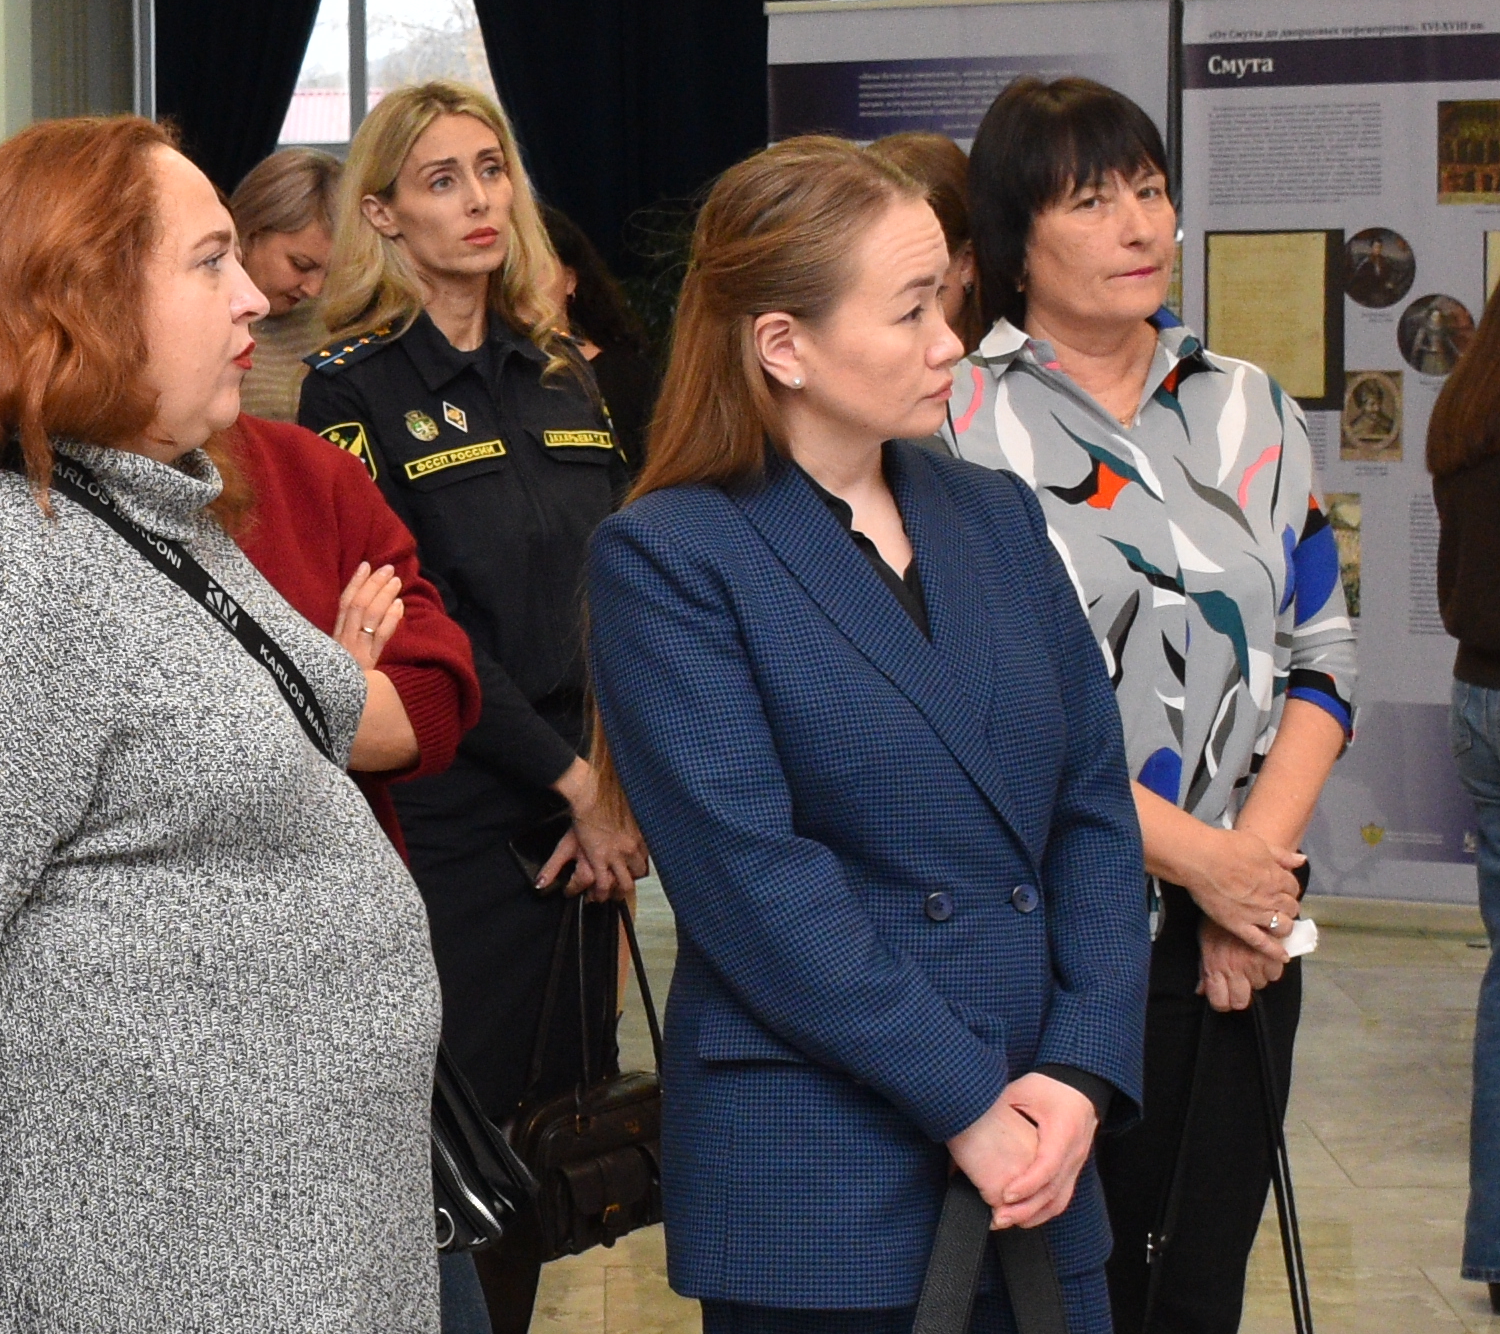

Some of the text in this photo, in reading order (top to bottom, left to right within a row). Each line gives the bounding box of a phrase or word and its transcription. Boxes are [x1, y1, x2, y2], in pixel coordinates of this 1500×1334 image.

[1207, 54, 1274, 79] Смута
[415, 444, 497, 473] ФССП РОССИИ
